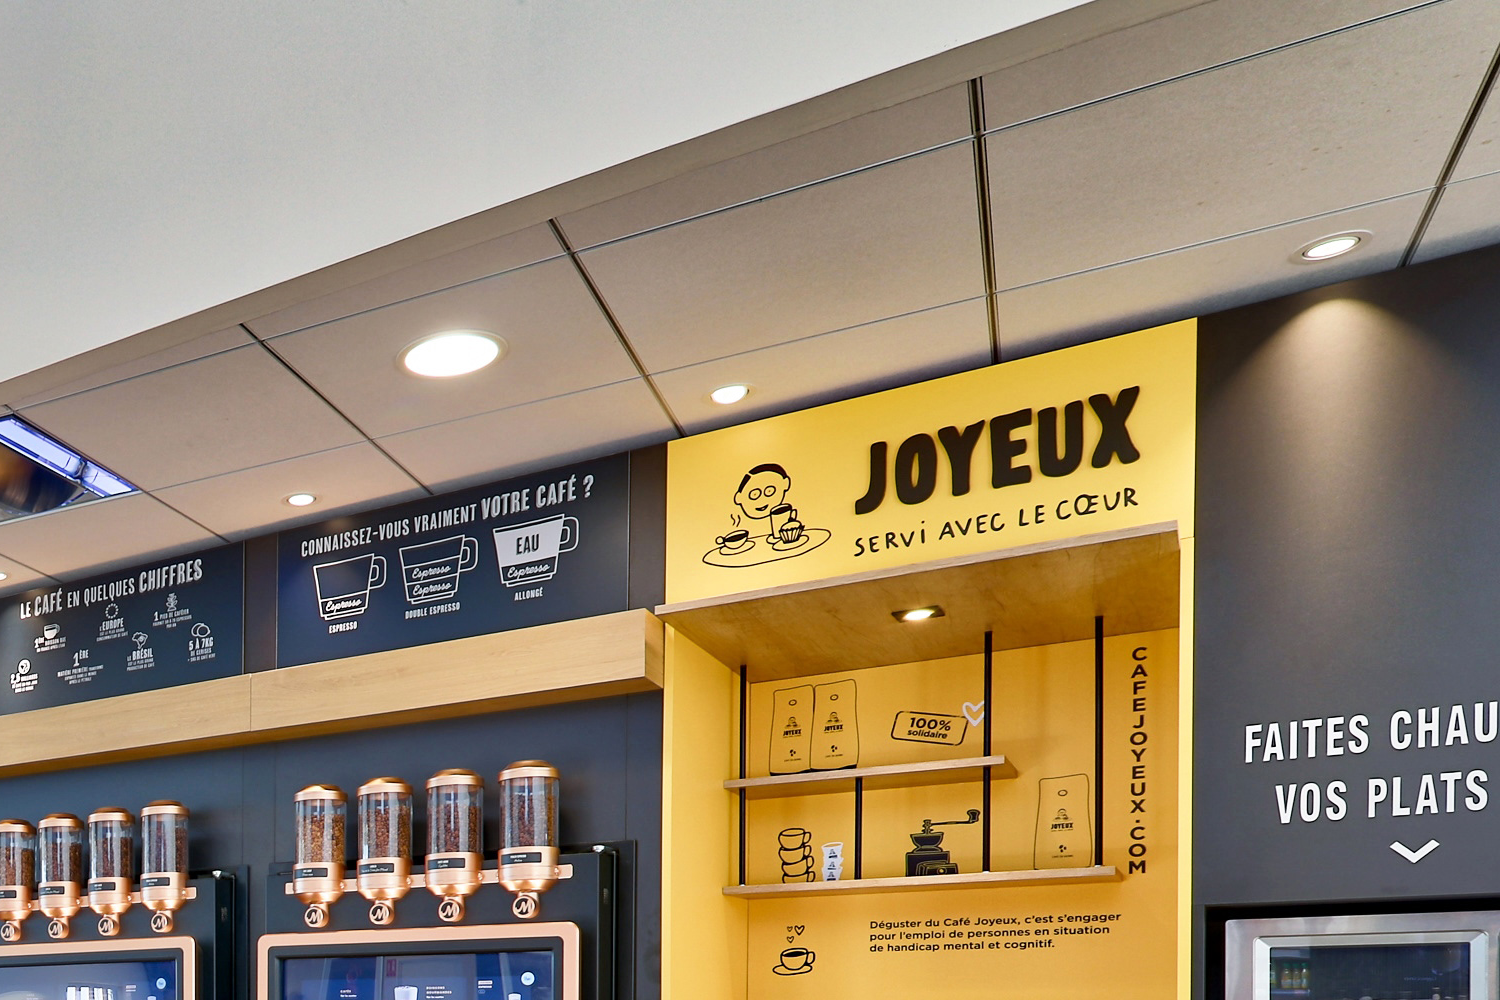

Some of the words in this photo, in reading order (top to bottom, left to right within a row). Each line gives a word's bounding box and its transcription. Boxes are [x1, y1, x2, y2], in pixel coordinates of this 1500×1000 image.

[855, 385, 1142, 516] JOYEUX
[301, 519, 410, 557] CONNAISSEZ-VOUS
[413, 504, 477, 533] VRAIMENT
[481, 488, 531, 520] VOTRE
[535, 473, 577, 508] CAFÉ
[938, 511, 1006, 542] AVEC
[1018, 502, 1046, 527] LE
[515, 533, 540, 555] EAU
[412, 564, 452, 580] Espresso
[507, 562, 550, 580] Espresso
[20, 601, 32, 619] LE
[34, 588, 63, 617] CAFÉ
[67, 593, 80, 608] EN
[84, 577, 135, 606] QUELQUES
[138, 558, 203, 593] CHIFFRES
[412, 581, 453, 598] Espresso
[514, 586, 543, 601] ALLONGÉ
[325, 598, 362, 613] Espresso
[405, 606, 428, 620] DOUBLE
[429, 602, 461, 617] ESPRESSO
[328, 621, 358, 634] ESPRESSO
[132, 648, 153, 661] BRÉSIL
[910, 717, 951, 731] 100%
[1244, 714, 1370, 764] FAITES
[1390, 700, 1498, 751] CHAU
[907, 730, 947, 739] solidaire
[1128, 646, 1148, 875] CAFEJOYEUX.COM
[1275, 780, 1348, 824] VOS
[1368, 769, 1488, 818] PLATS
[870, 920, 921, 930] Déguster
[925, 919, 940, 927] du
[944, 917, 970, 927] Café
[974, 917, 1021, 926] Joyeux,
[1024, 915, 1053, 924] c'est
[1058, 914, 1122, 924] s'engager
[870, 933, 896, 942] pour
[900, 930, 945, 940] l'emploi
[949, 930, 963, 938] de
[968, 928, 1030, 939] personnes
[1054, 926, 1110, 935] situation
[870, 944, 884, 952] de
[887, 943, 940, 952] handicap
[944, 941, 984, 950] mental
[1004, 939, 1055, 950] cognitif.
